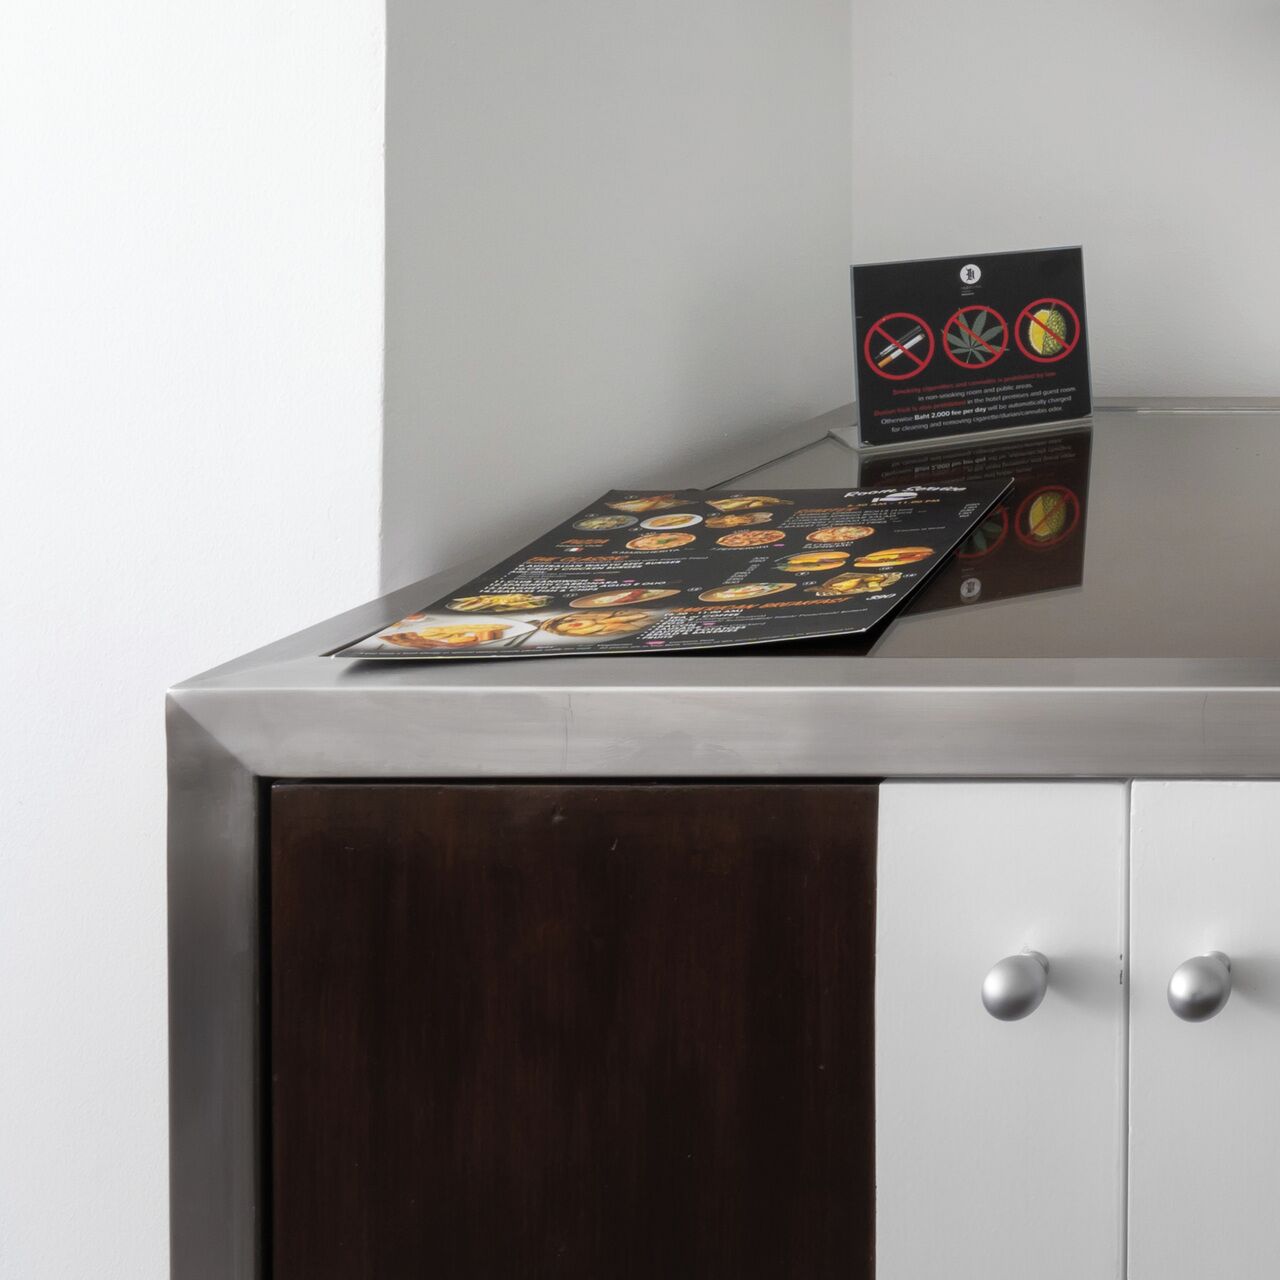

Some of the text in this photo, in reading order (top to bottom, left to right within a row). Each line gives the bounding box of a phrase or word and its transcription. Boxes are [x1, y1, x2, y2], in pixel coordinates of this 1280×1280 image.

[925, 390, 965, 401] non-smoking
[996, 384, 1014, 393] public
[985, 394, 1001, 402] hotel
[1042, 388, 1059, 396] guest
[914, 413, 930, 421] Baht
[962, 408, 974, 416] per
[974, 406, 987, 415] day
[1007, 399, 1047, 409] automatically
[1047, 395, 1072, 404] charged
[891, 425, 901, 433] for
[901, 423, 929, 432] cleaning
[942, 418, 972, 427] removing
